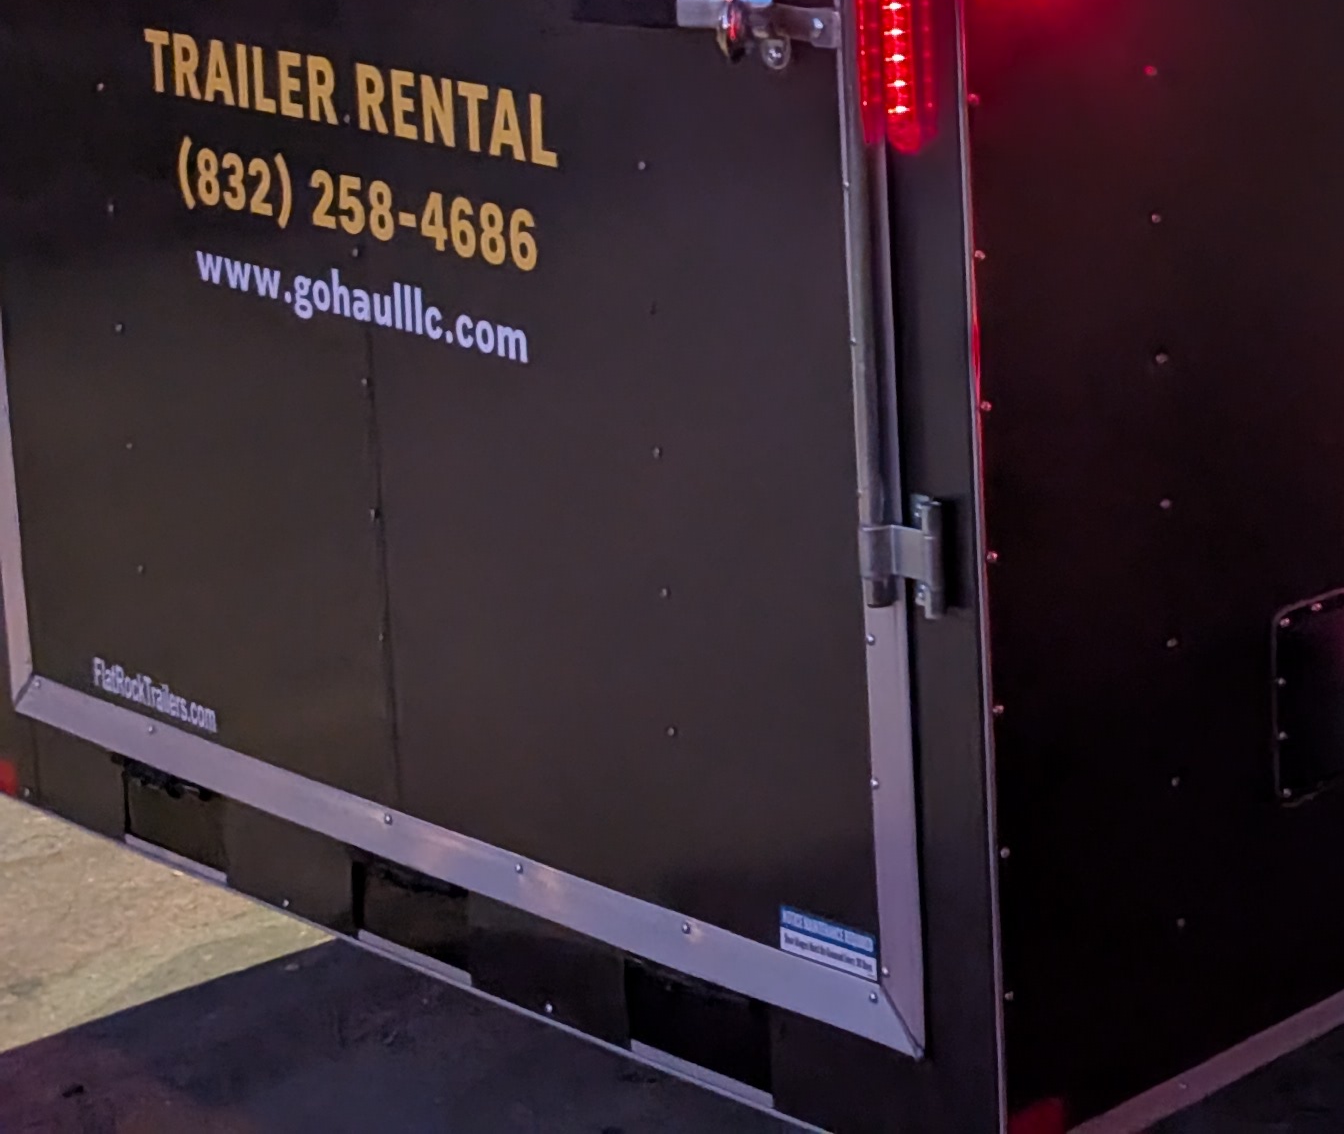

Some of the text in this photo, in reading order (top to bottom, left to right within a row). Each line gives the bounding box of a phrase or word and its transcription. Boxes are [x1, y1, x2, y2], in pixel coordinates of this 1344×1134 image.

[143, 27, 559, 169] TRAILER RENTAL
[177, 136, 538, 272] (832) 258-4686
[195, 250, 529, 364] www.gohaulllc.com
[92, 655, 218, 734] FlatRockTrailers.com
